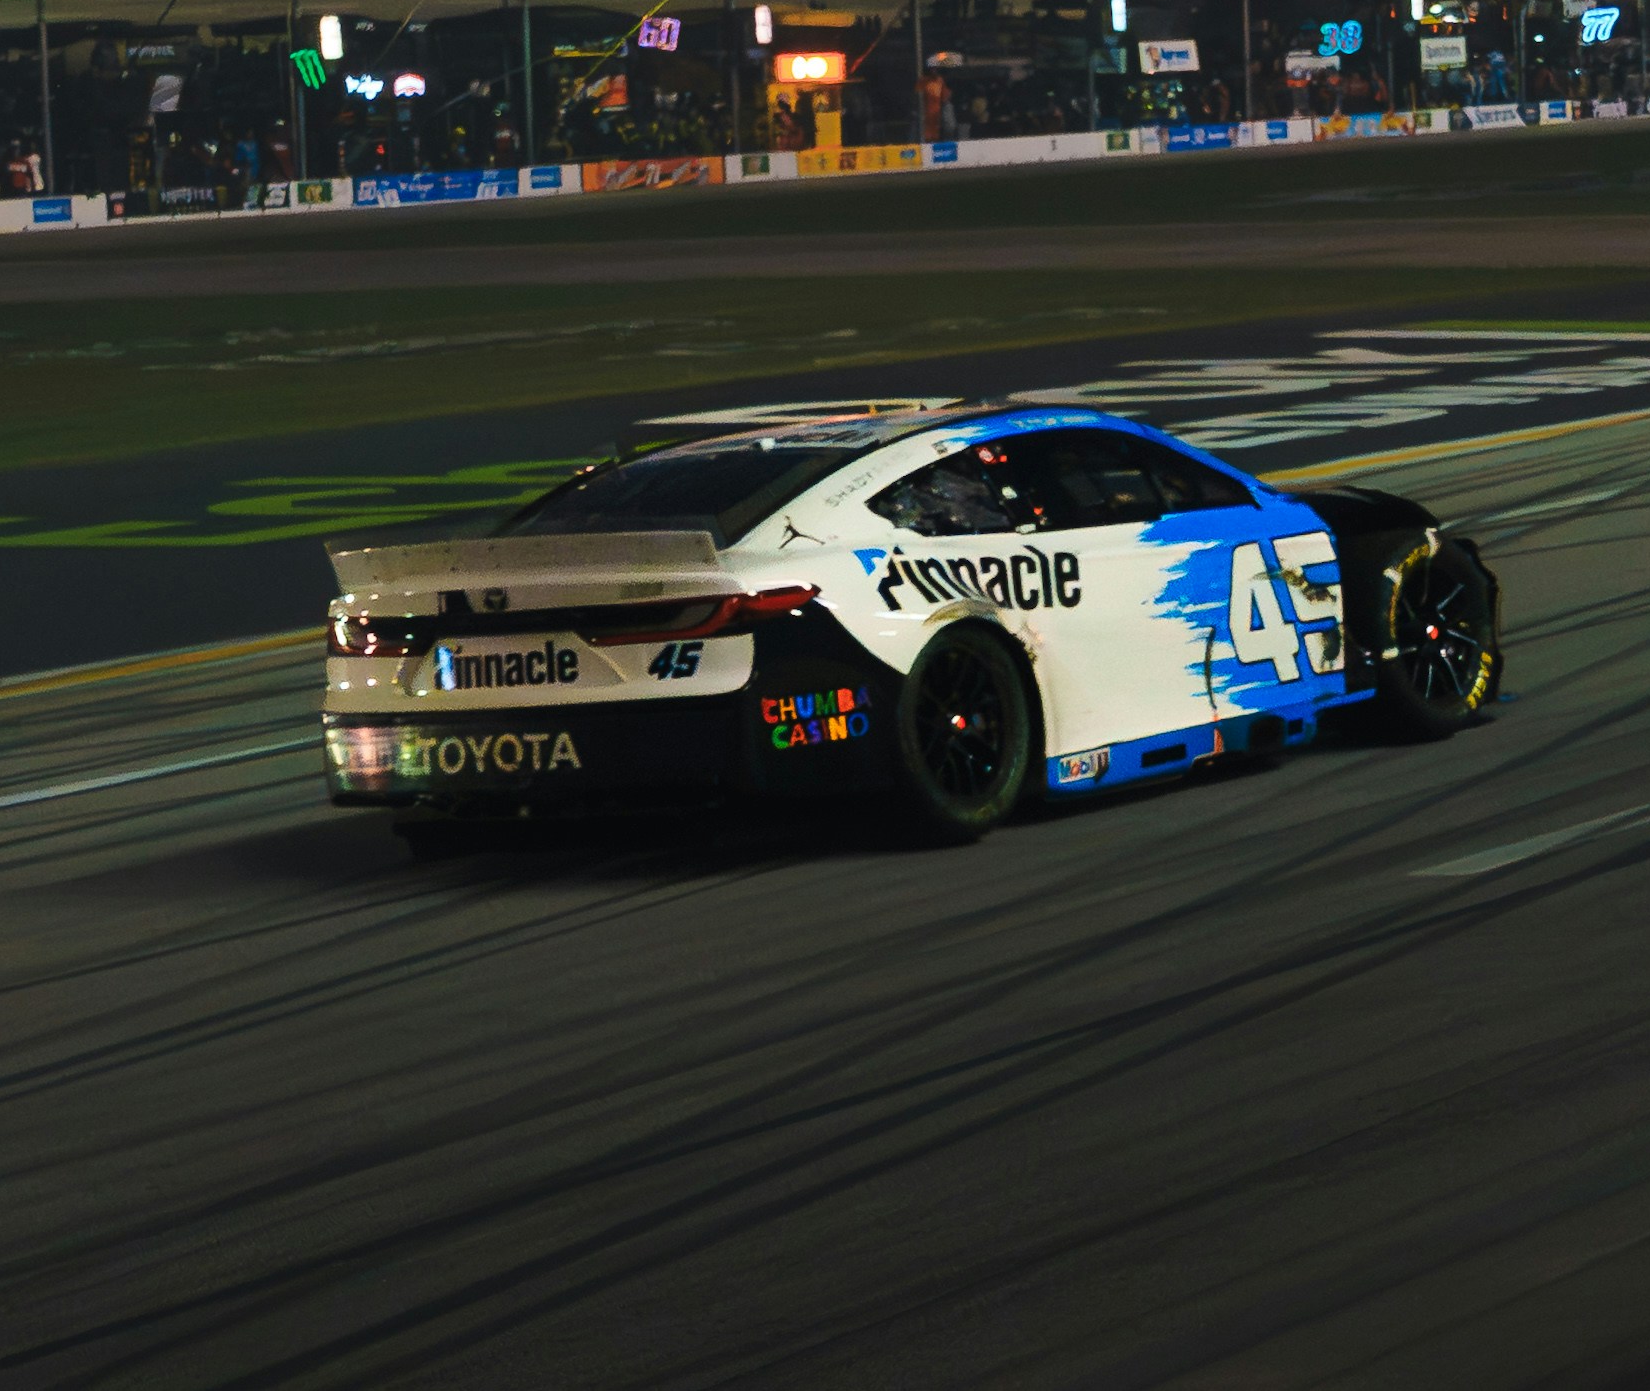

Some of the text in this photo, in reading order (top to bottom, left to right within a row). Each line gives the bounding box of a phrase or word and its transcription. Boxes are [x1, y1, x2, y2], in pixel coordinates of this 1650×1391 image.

[638, 17, 681, 51] 60
[1318, 19, 1363, 55] 38
[1230, 531, 1345, 684] 45
[648, 640, 704, 681] 45
[760, 687, 873, 725] CHUMBA
[771, 712, 871, 750] CASINO
[414, 731, 583, 775] TOYOTA
